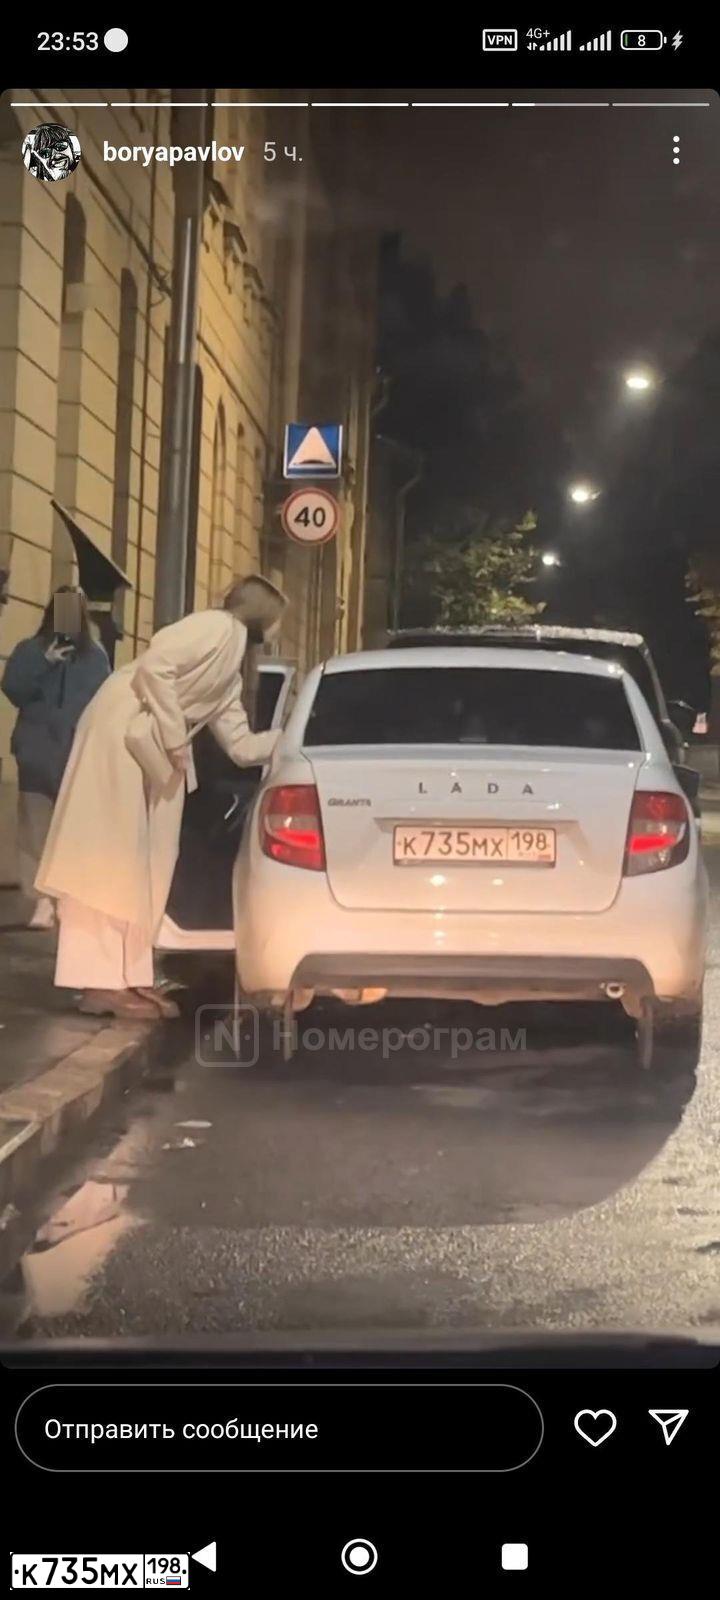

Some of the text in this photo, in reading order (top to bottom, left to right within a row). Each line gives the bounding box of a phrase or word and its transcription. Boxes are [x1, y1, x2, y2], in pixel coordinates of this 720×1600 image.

[294, 506, 326, 528] 40
[418, 782, 534, 795] LADA
[511, 831, 547, 851] 198
